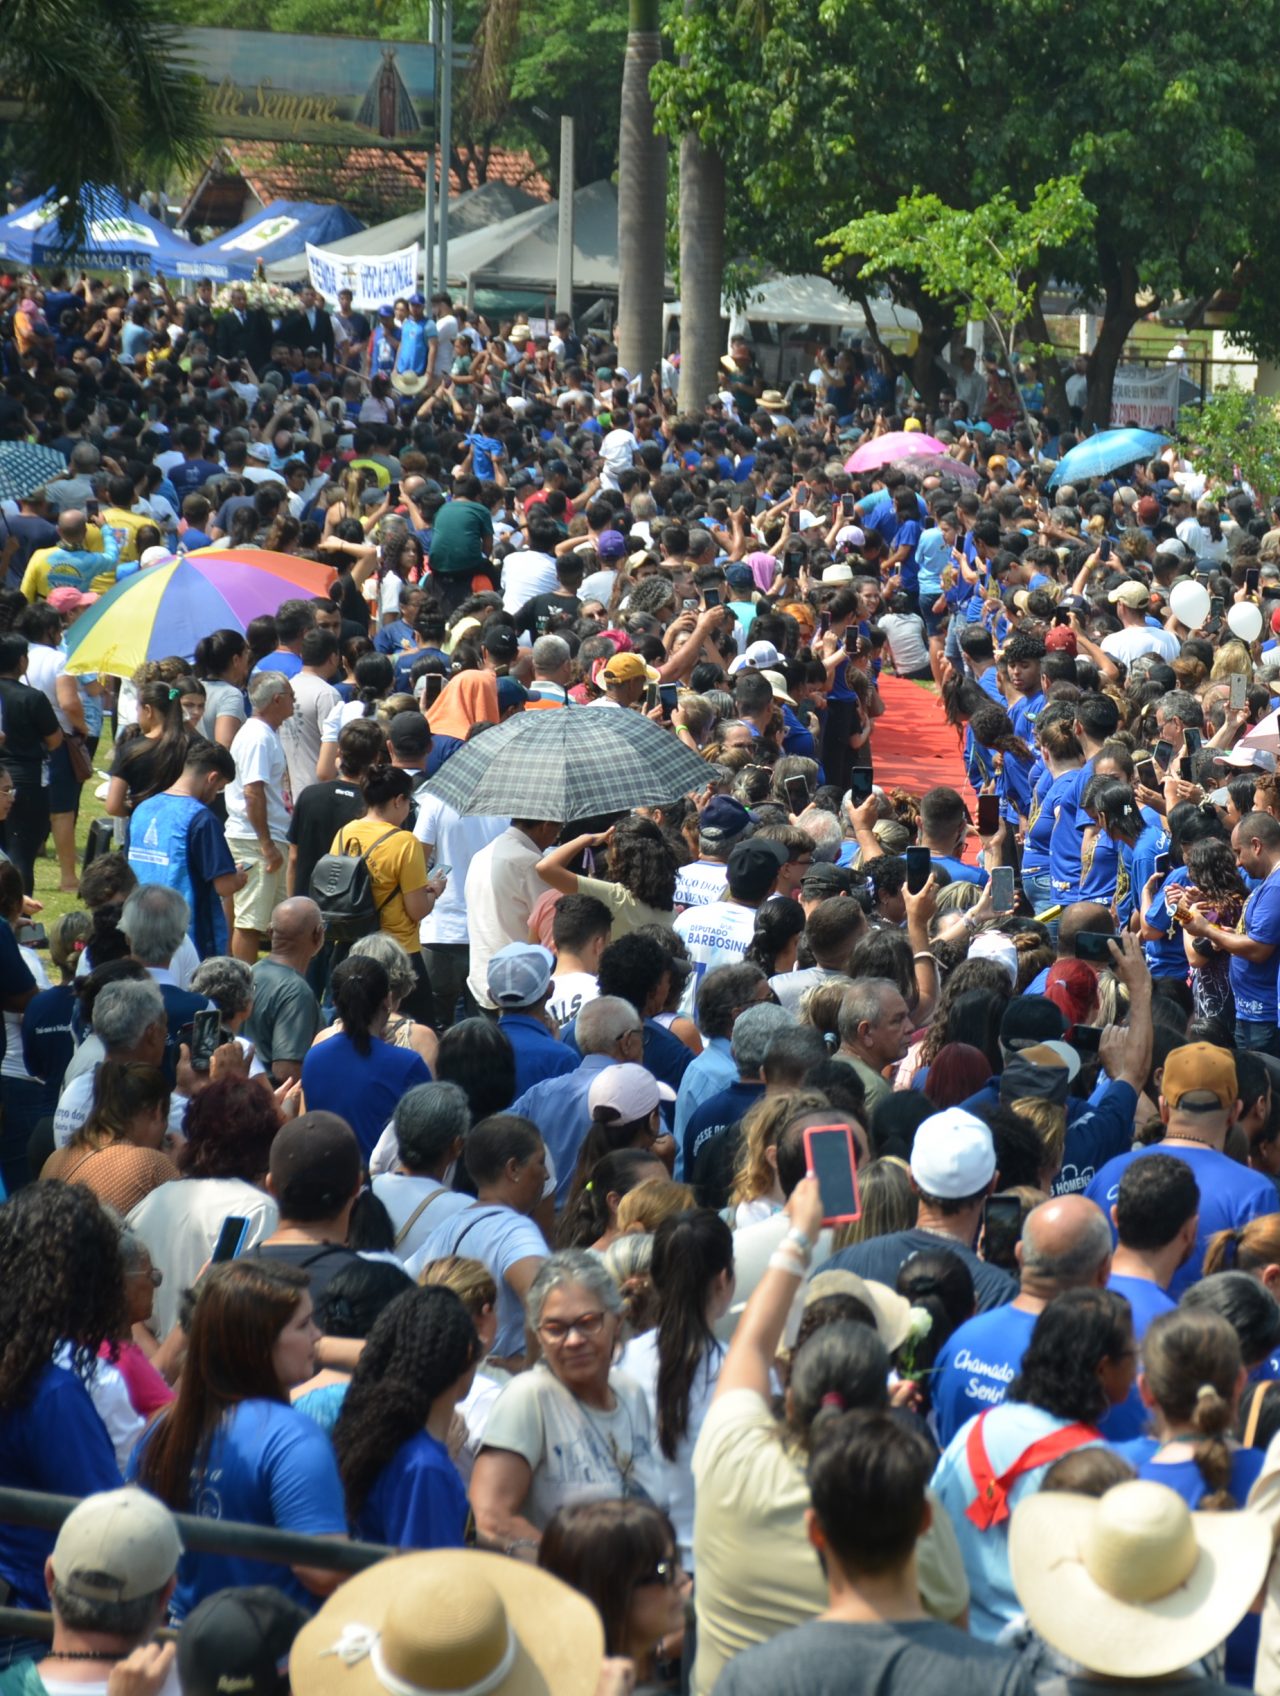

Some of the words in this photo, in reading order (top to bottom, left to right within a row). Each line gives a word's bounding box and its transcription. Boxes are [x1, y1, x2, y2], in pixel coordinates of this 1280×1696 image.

[690, 924, 728, 937] DEPUTADO
[687, 932, 749, 954] BARBOSINH
[953, 1348, 1015, 1384] Chamado
